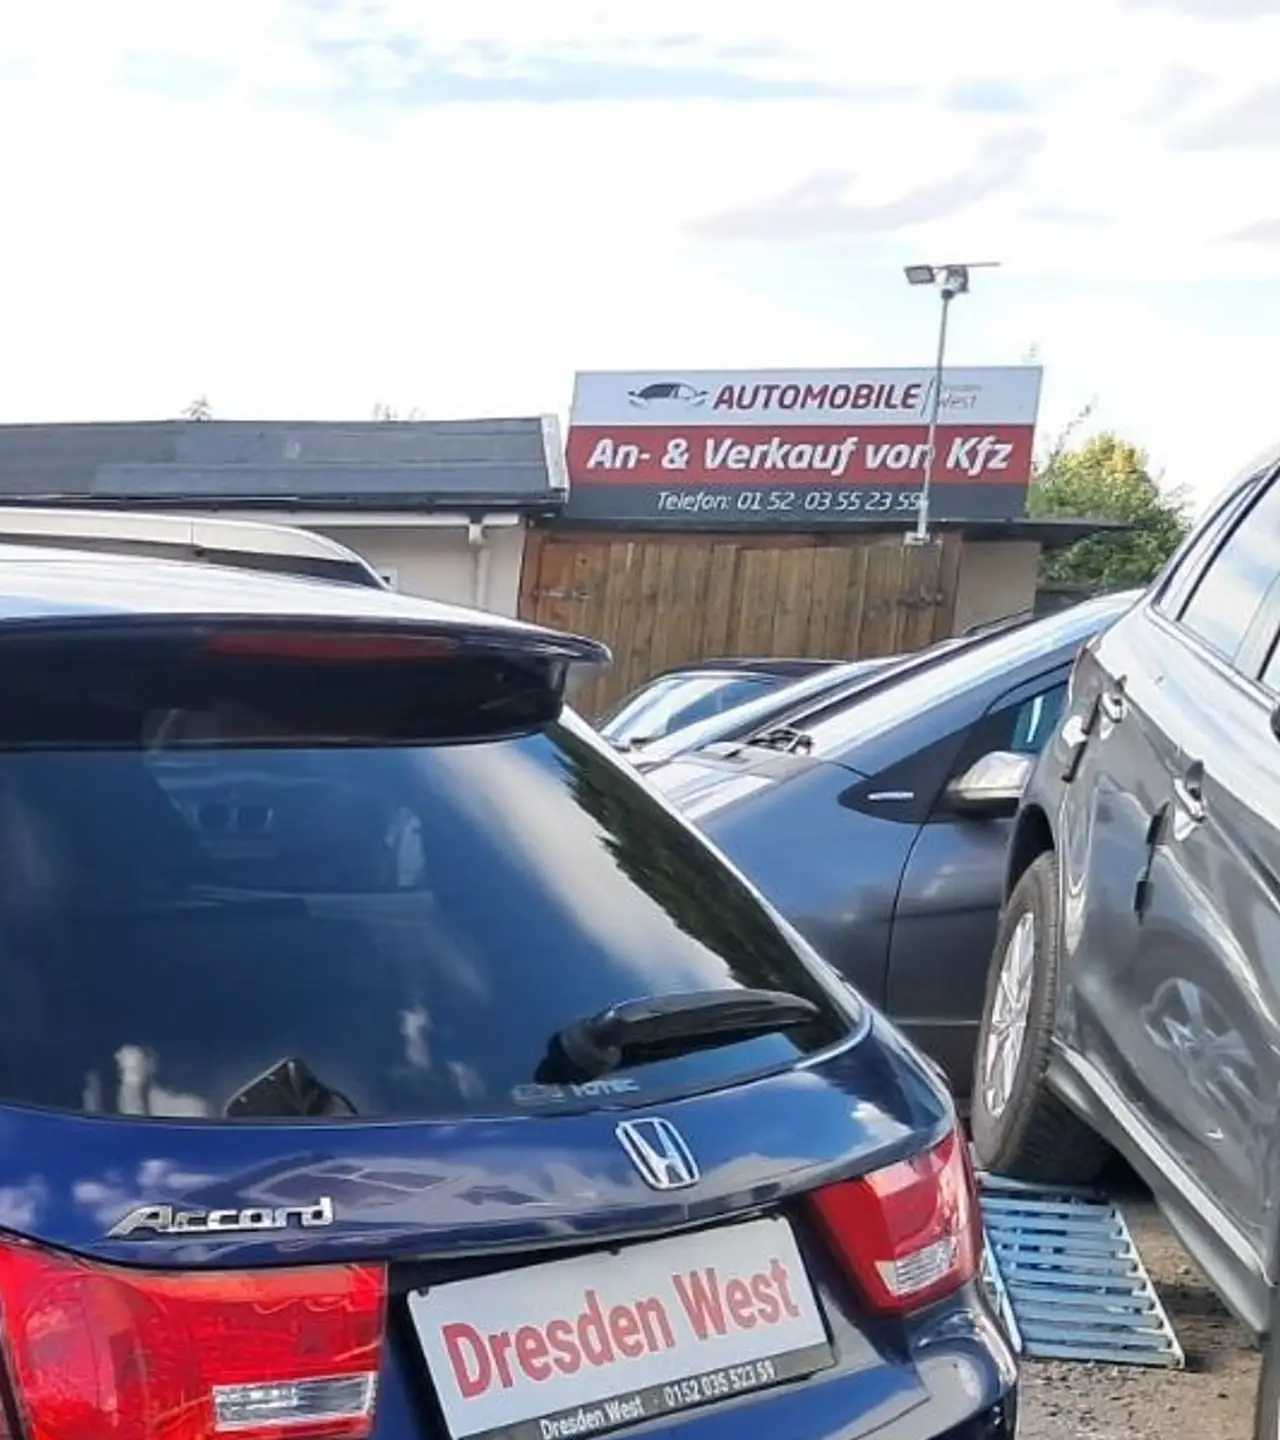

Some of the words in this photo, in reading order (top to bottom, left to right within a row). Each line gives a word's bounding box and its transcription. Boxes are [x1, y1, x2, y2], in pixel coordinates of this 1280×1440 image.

[713, 384, 922, 411] AUTOMOBILE
[587, 437, 650, 470] An-
[661, 437, 689, 470] &
[704, 436, 859, 476] Verkauf
[865, 443, 935, 470] von
[946, 436, 1014, 477] Kfz
[657, 491, 732, 512] Telefon:
[737, 491, 762, 511] 01
[766, 491, 795, 511] 52
[804, 491, 833, 511] 03
[835, 491, 863, 511] 55
[864, 491, 893, 511] 23
[106, 1196, 334, 1240] Accord
[442, 1288, 676, 1399] Dresden
[671, 1257, 801, 1341] West
[540, 1407, 606, 1440] Dresden
[603, 1395, 644, 1423] West
